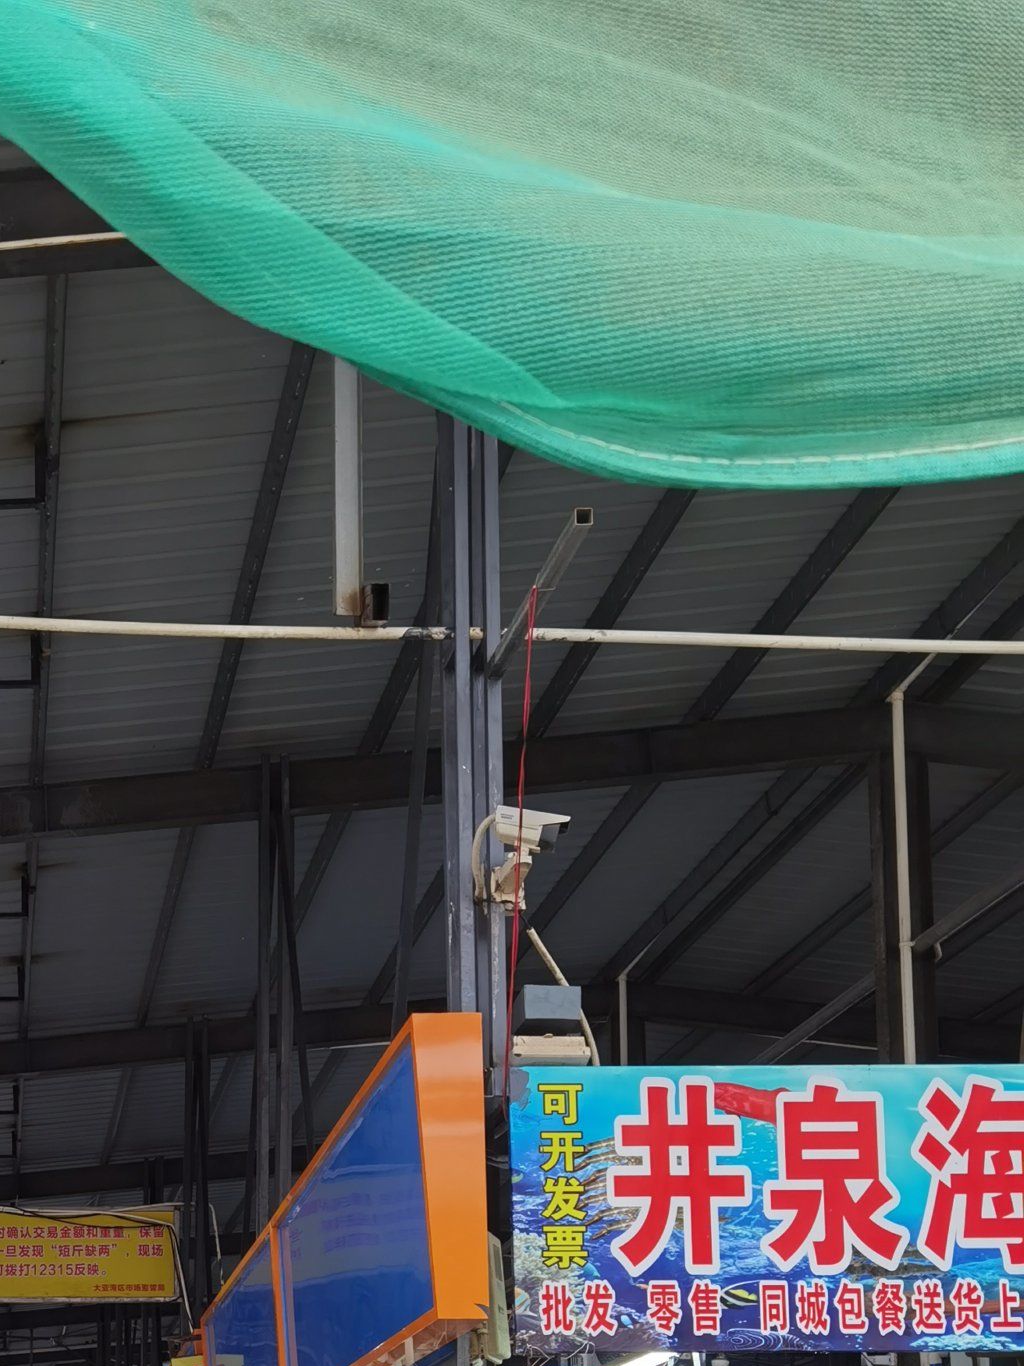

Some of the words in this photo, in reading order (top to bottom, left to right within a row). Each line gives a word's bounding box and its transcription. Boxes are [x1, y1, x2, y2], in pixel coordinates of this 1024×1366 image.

[538, 1082, 588, 1270] 可开发票
[609, 1078, 1024, 1274] 井泉海
[540, 1280, 617, 1336] 批发
[648, 1280, 722, 1336] 零售
